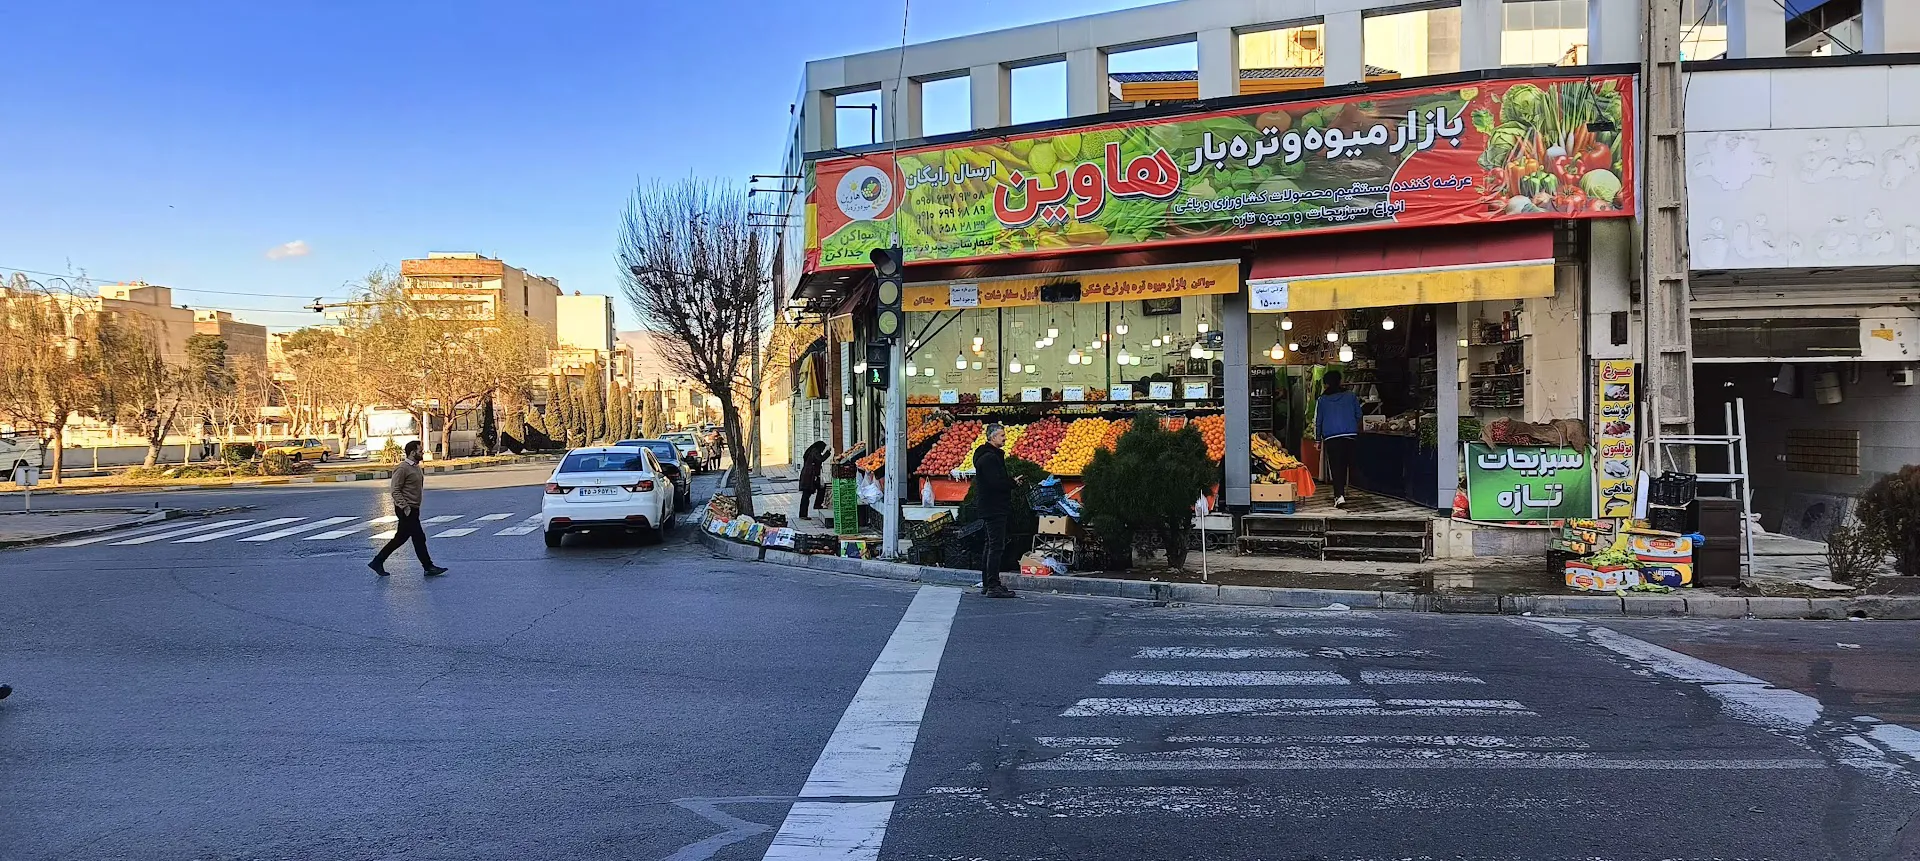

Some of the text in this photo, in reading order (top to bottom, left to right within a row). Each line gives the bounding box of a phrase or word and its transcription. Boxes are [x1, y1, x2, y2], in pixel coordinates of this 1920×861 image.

[1187, 106, 1463, 174] بازار میوه و تره بار
[905, 158, 996, 190] ارسال رایگان
[993, 142, 1182, 229] هاوین
[1174, 175, 1473, 214] عرضه کننده مستقیم محصولات کشاورزی و باغی
[1232, 199, 1406, 228] انواع سبزیجات و میوه تازه
[825, 247, 863, 262] جداکن
[1020, 286, 1039, 301] قبول
[1118, 281, 1130, 296] بار
[1131, 280, 1146, 294] تره
[1147, 282, 1166, 293] میوه
[1166, 277, 1187, 292] بازار
[913, 296, 935, 306] جداکن
[984, 289, 1019, 302] سفارشات
[1260, 299, 1281, 308] ۱۵۰۰۰
[1602, 361, 1633, 381] مرغ
[1602, 402, 1634, 421] گوشت
[1602, 440, 1634, 459] بوقلمون
[1478, 447, 1584, 477] سبزیجات
[1602, 480, 1633, 499] ماهی
[1497, 484, 1563, 515] تازه
